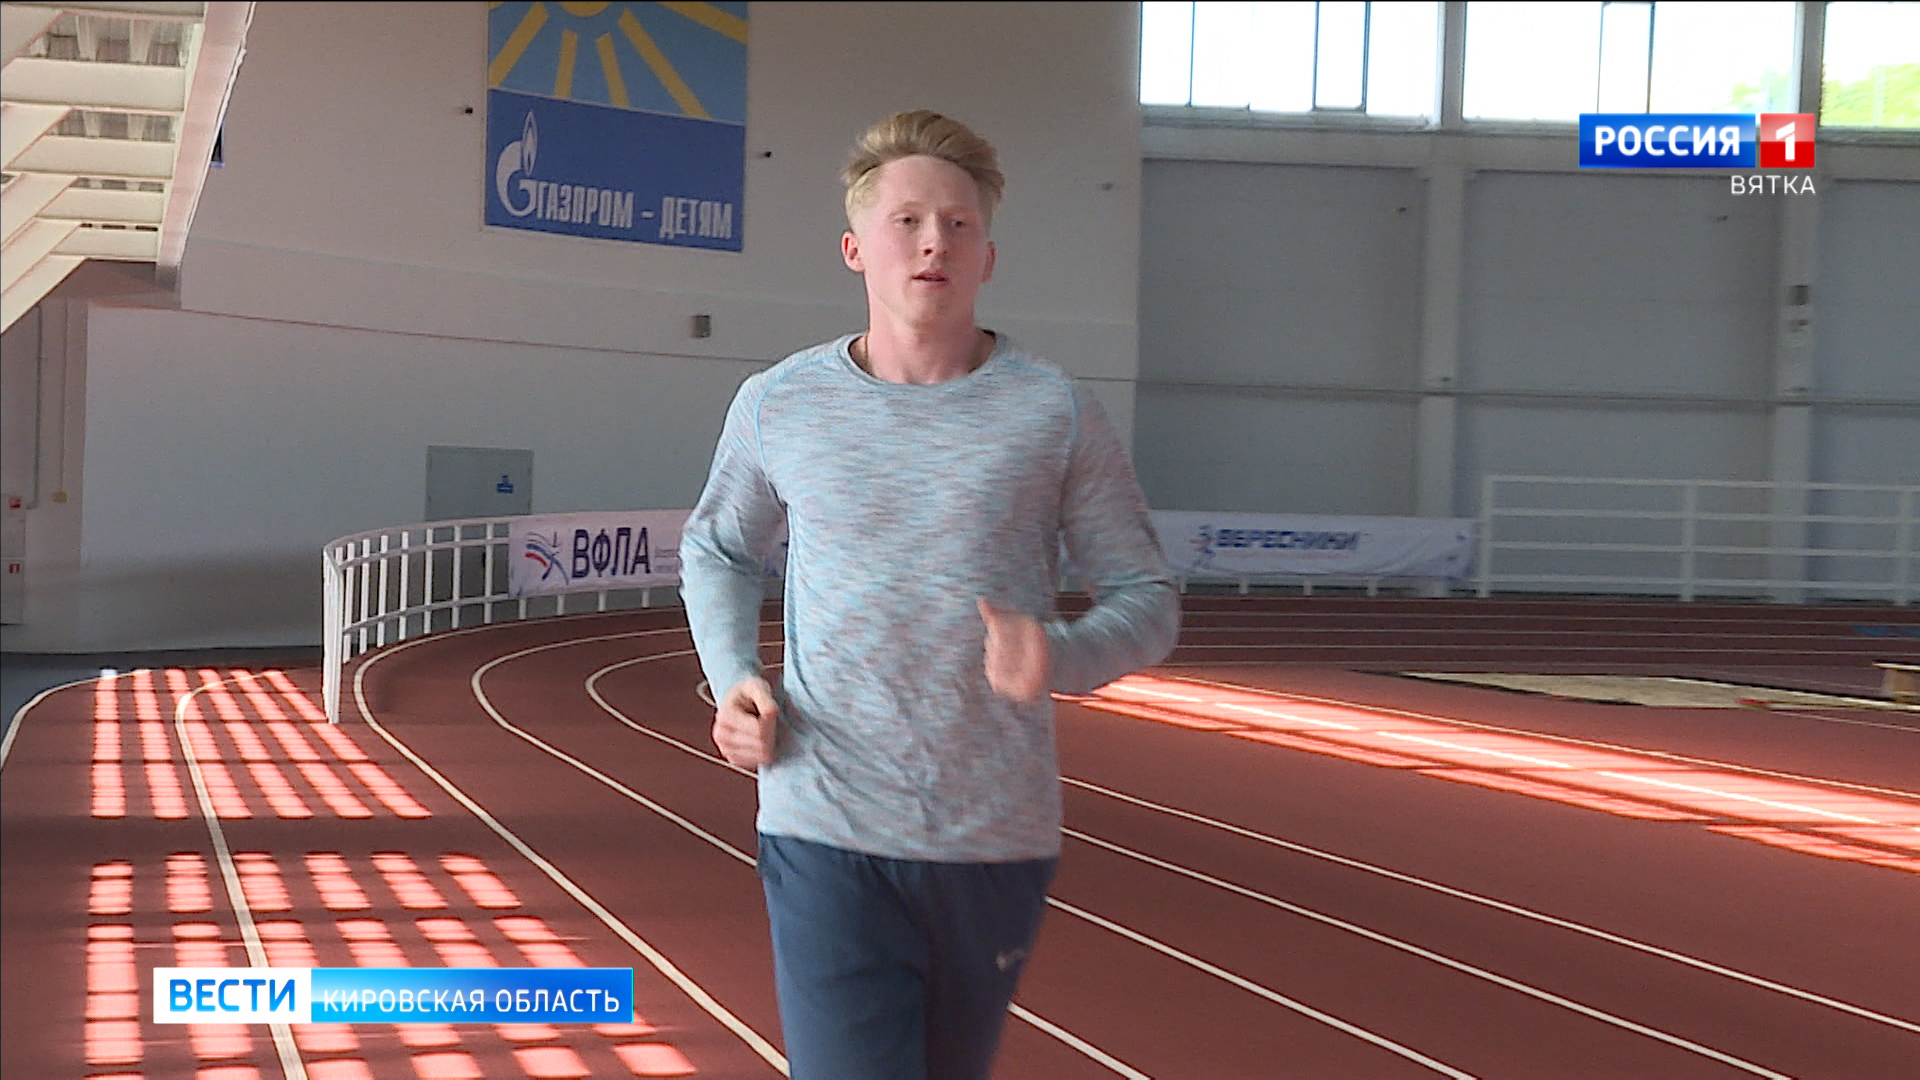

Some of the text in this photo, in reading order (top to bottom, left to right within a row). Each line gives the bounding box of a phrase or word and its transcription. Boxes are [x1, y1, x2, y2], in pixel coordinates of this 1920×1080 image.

[536, 181, 634, 229] ГАЗПРОМ
[659, 196, 733, 240] ДЕТЯМ
[571, 527, 651, 578] ВФЛА
